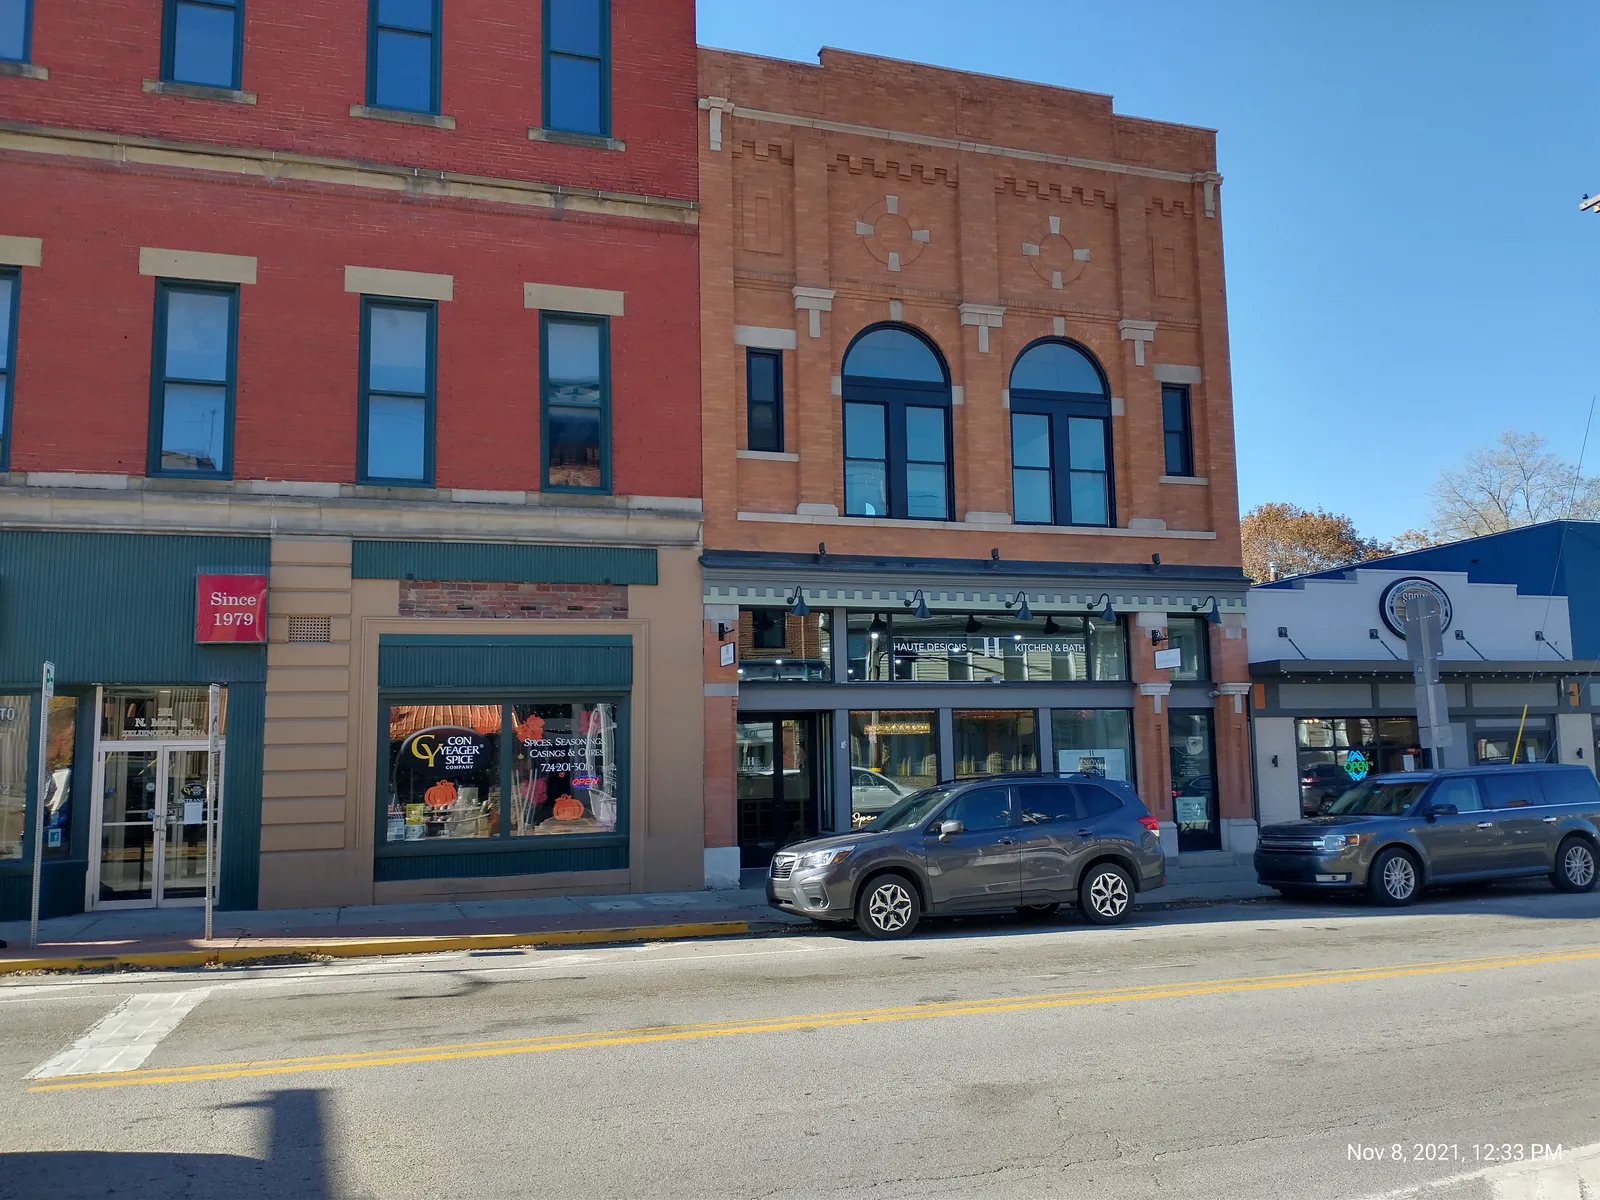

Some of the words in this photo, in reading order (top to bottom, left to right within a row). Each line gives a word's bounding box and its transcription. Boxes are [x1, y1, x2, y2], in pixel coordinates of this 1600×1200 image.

[210, 592, 257, 606] Since
[214, 613, 254, 626] 1979
[893, 643, 925, 652] HAUTE
[927, 643, 967, 652] DESIGNS
[983, 637, 1000, 658] H
[1014, 643, 1053, 652] KITCHEN
[1054, 643, 1061, 652] &
[1062, 643, 1086, 652] BATH
[135, 718, 147, 727] N.
[151, 718, 178, 727] Main
[447, 736, 473, 746] CON
[440, 745, 481, 755] YEAGER
[529, 749, 566, 758] CASINGS
[567, 748, 576, 757] &
[445, 755, 474, 765] SPICE
[1344, 761, 1369, 772] OPEN
[572, 778, 599, 786] OPEN
